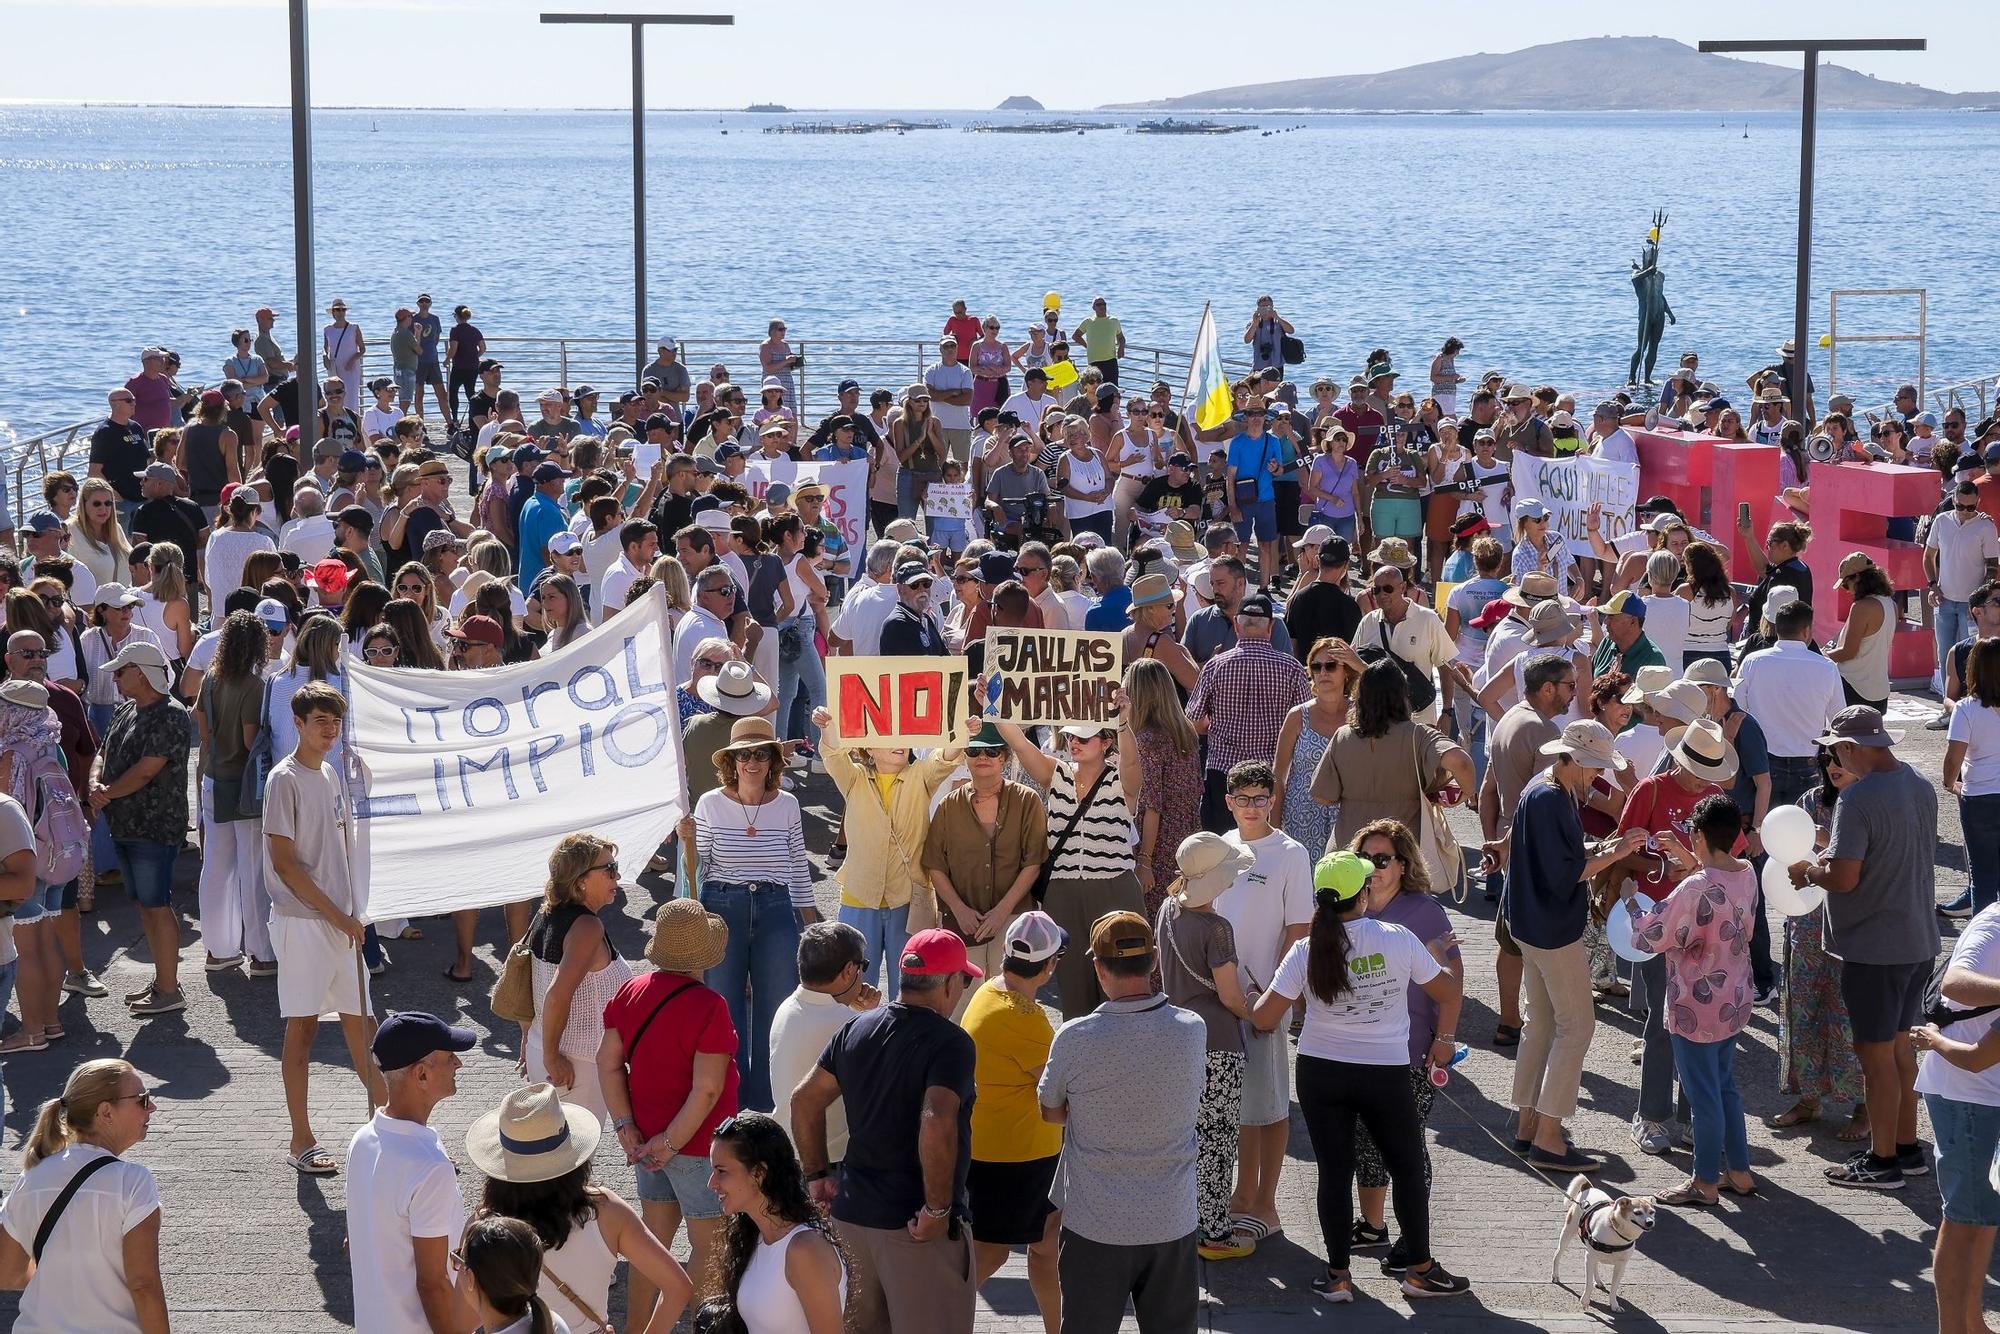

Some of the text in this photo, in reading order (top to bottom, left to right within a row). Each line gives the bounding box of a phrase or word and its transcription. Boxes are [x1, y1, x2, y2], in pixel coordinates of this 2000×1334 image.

[1380, 424, 1401, 434] DEP
[1557, 507, 1627, 542] MUETO
[997, 635, 1116, 673] JAULAS
[840, 671, 964, 743] NO!
[345, 703, 668, 819] LIMPIO
